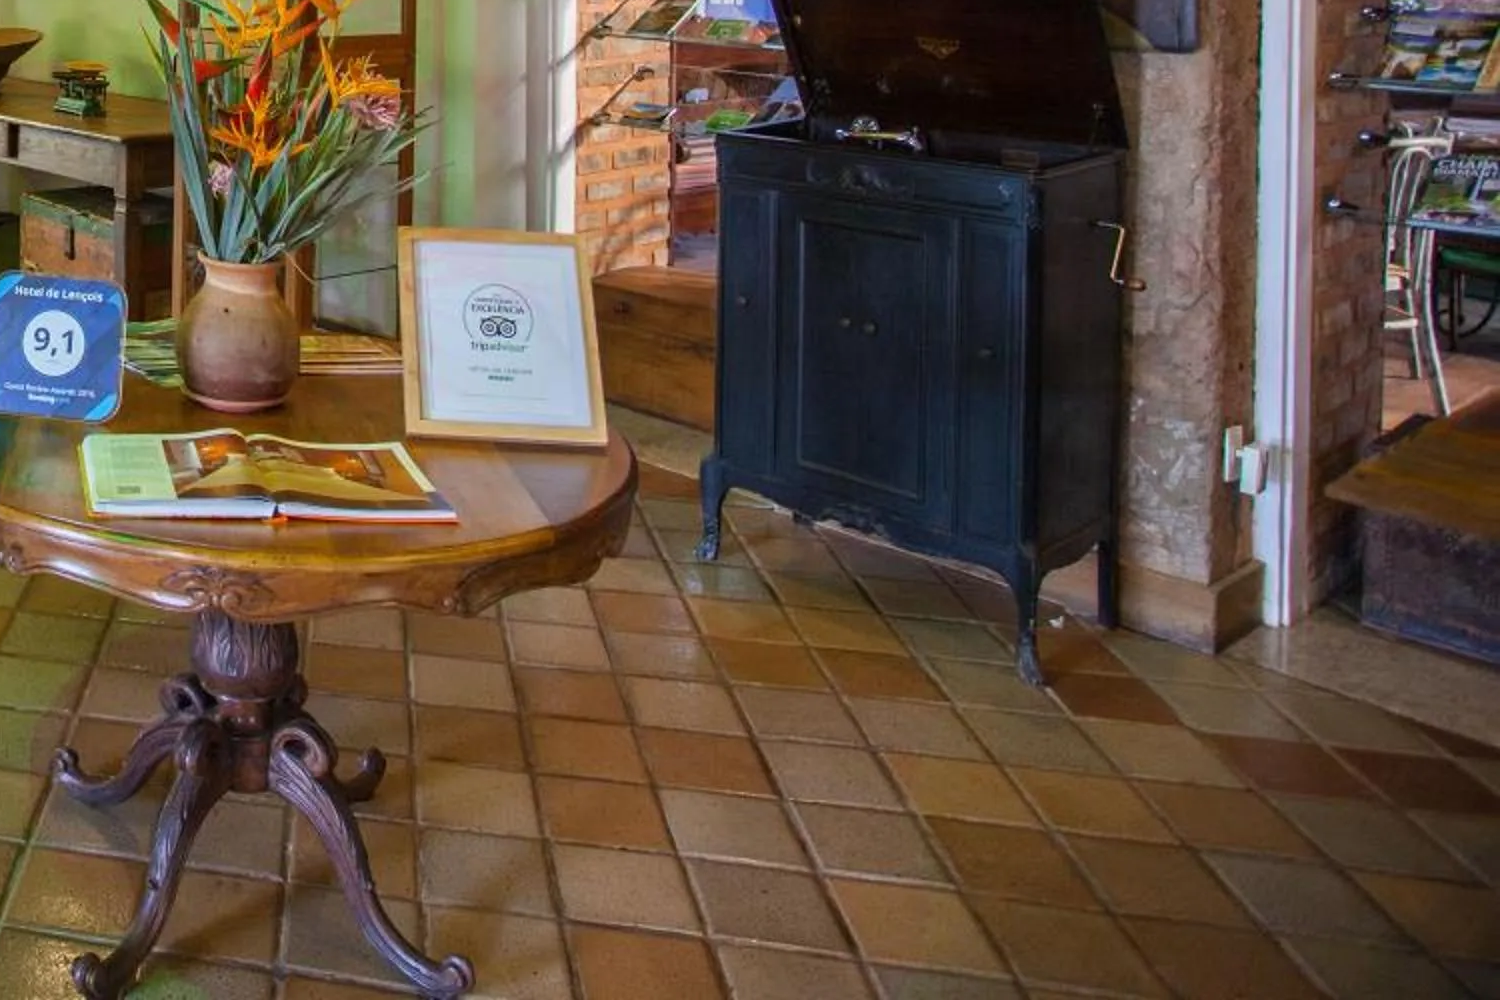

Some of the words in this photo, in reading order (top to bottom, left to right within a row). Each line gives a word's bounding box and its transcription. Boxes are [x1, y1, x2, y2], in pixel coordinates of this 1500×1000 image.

[14, 285, 45, 296] Hotel
[45, 287, 60, 299] de
[33, 327, 74, 357] 9,1
